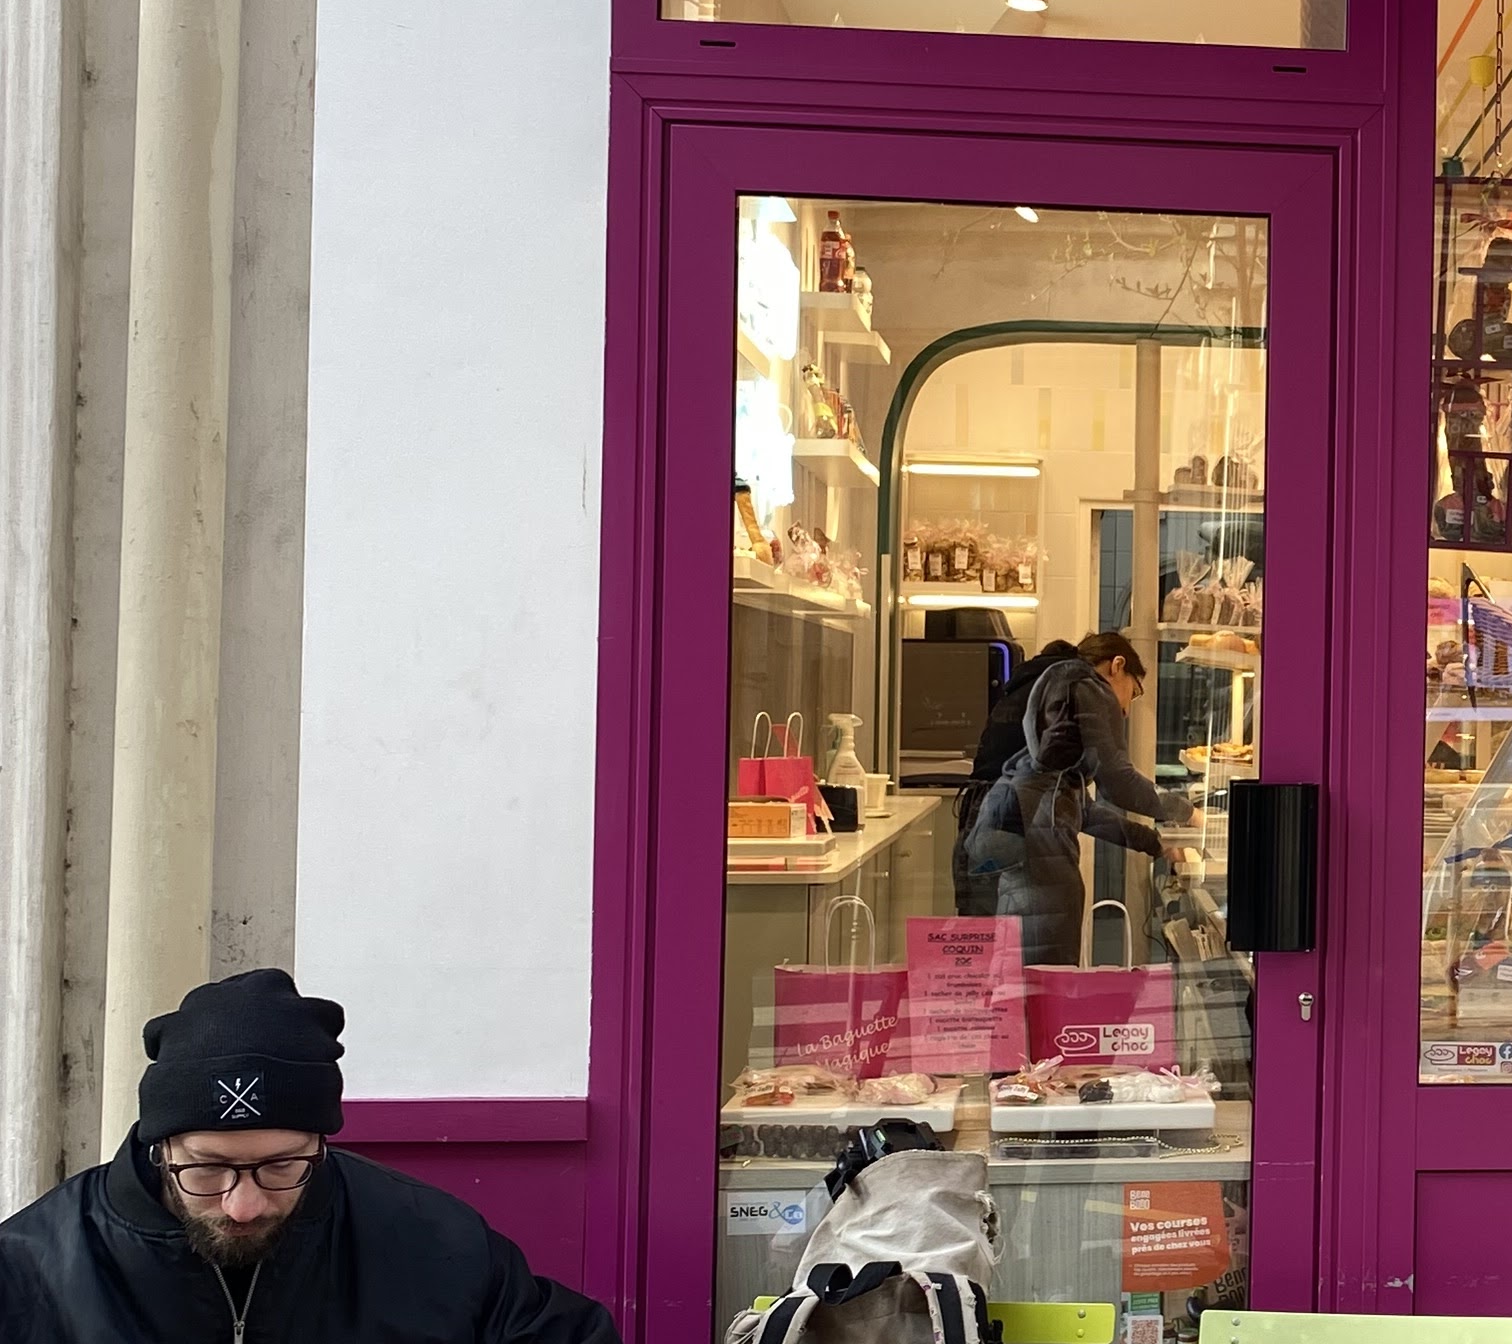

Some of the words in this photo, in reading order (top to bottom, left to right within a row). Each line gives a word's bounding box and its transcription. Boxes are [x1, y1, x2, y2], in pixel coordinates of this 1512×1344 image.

[928, 932, 948, 942] SAC
[951, 932, 996, 941] SURPRISE
[942, 945, 984, 955] COQUIN
[797, 1042, 818, 1057] La
[819, 1015, 899, 1051] Baguette
[1103, 1026, 1149, 1040] Legay
[1111, 1041, 1149, 1052] choc
[1459, 1046, 1493, 1056] Legay
[1465, 1055, 1492, 1064] choc
[250, 1092, 259, 1102] A
[1130, 1221, 1155, 1233] Vos
[1156, 1216, 1208, 1231] courses
[1153, 1243, 1165, 1251] de
[1166, 1242, 1189, 1251] chez
[1189, 1239, 1211, 1248] vous
